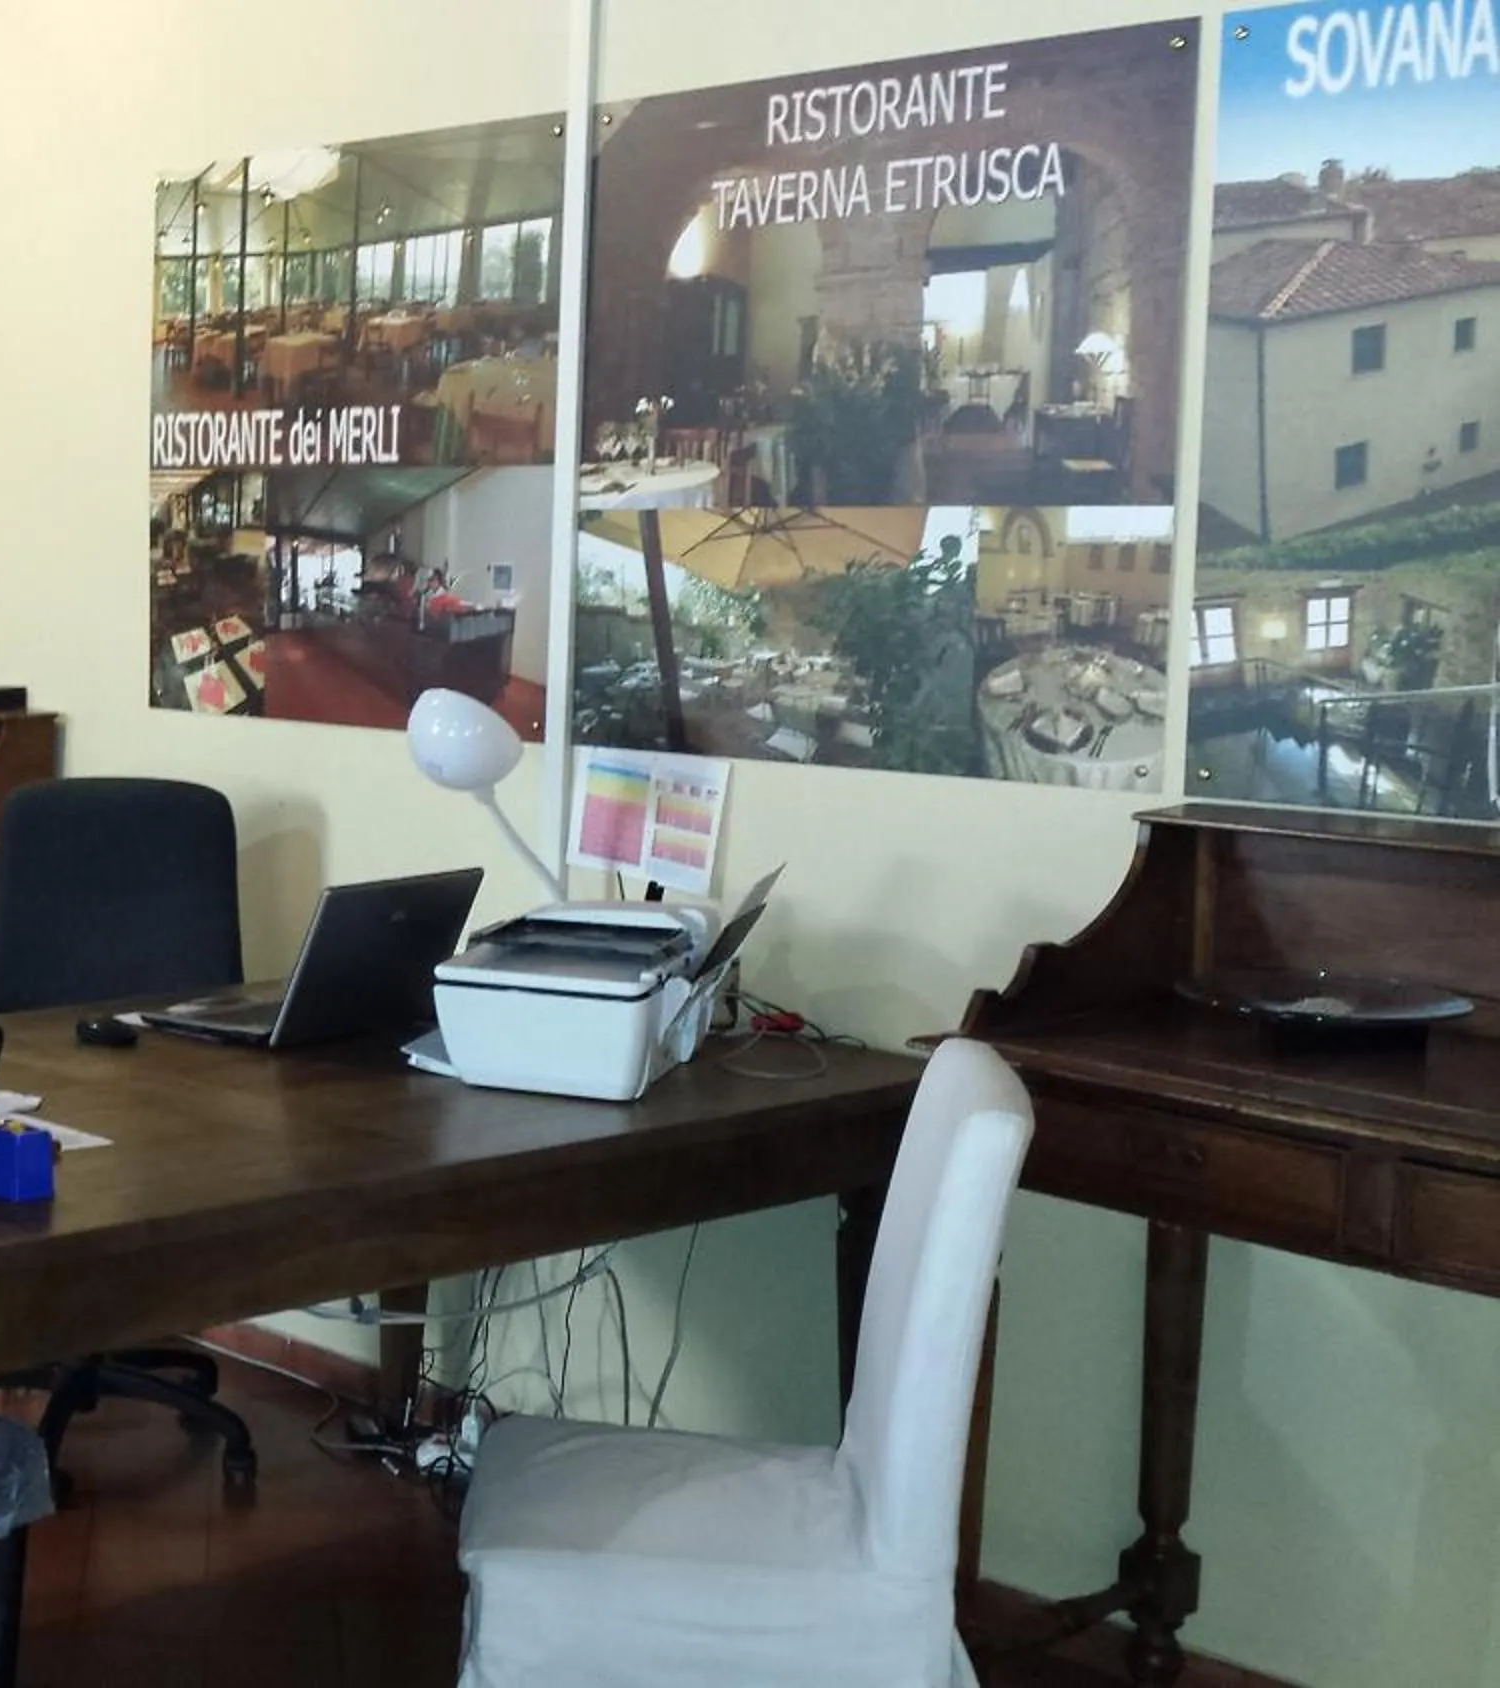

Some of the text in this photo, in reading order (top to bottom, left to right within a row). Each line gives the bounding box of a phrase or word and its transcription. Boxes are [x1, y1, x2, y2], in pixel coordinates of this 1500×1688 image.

[1285, 0, 1499, 98] SOVANA
[766, 63, 1009, 146] RISTORANTE
[711, 142, 1066, 231] TAVERNA ETRUSCA
[152, 404, 401, 467] RISTORANTE dei MERLI
